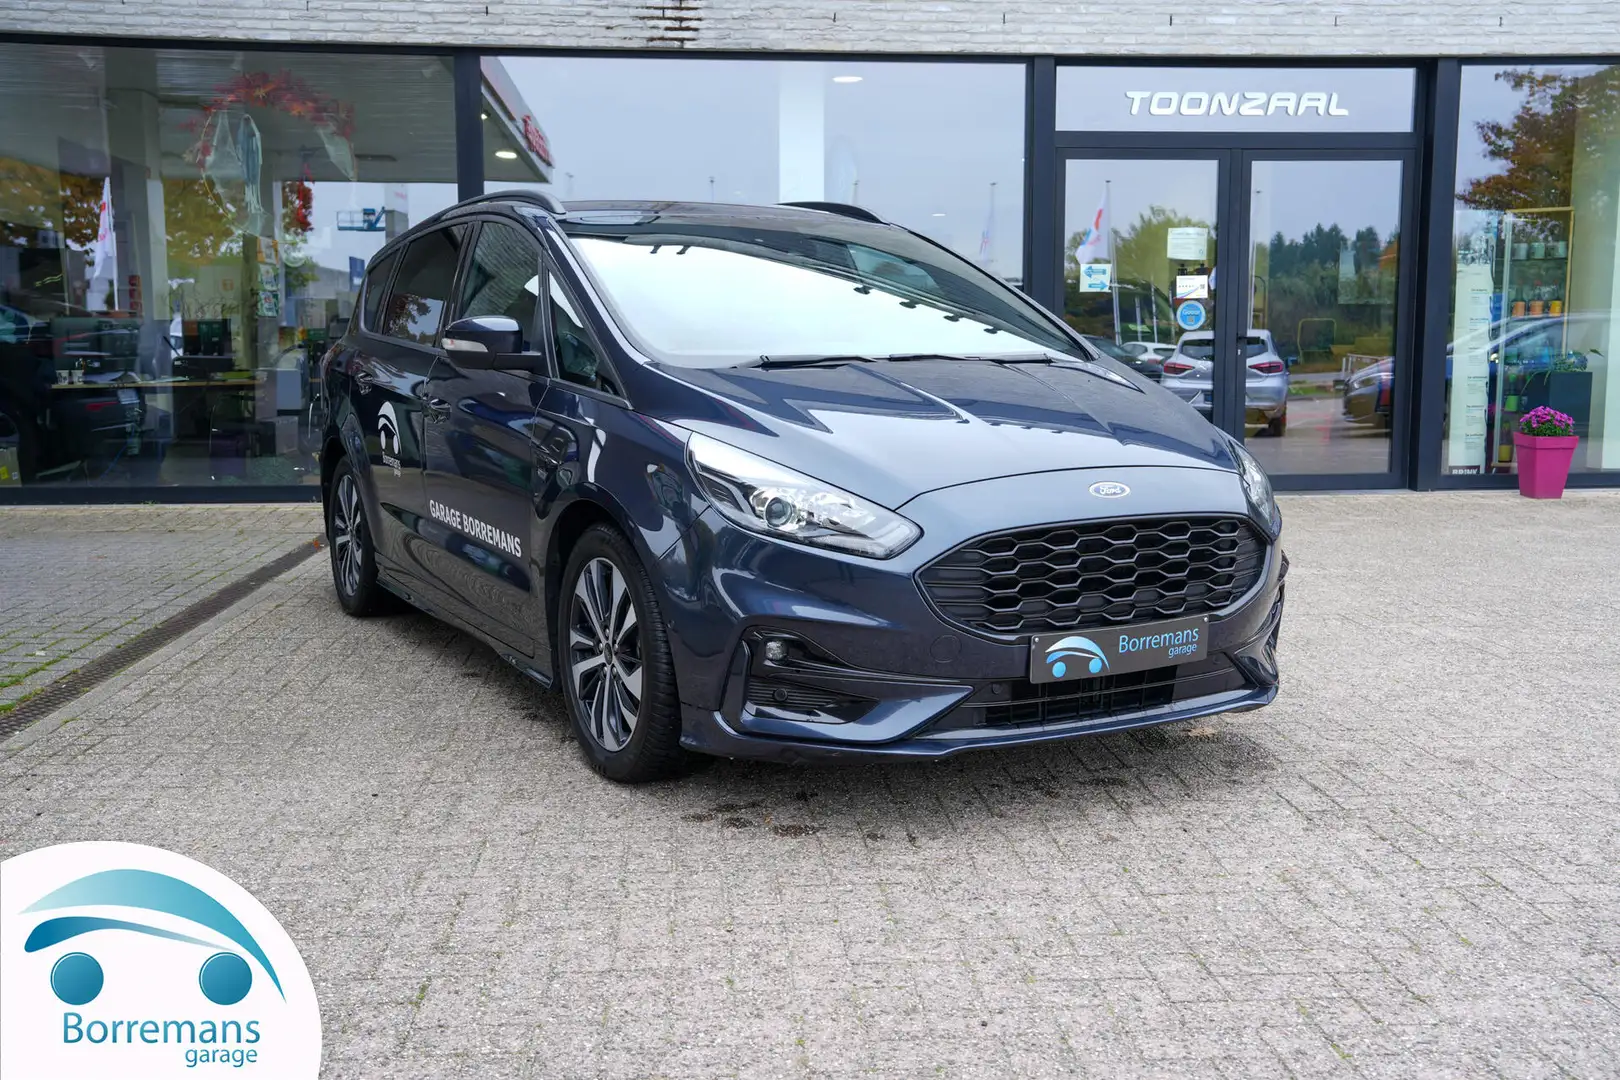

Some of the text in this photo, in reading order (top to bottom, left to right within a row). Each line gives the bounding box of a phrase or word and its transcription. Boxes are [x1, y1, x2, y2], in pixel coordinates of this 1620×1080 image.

[1125, 91, 1349, 116] TOONZAAL
[429, 500, 522, 557] GARAGE BORREMANS
[1118, 627, 1199, 653] Borremans
[1168, 643, 1197, 659] garage
